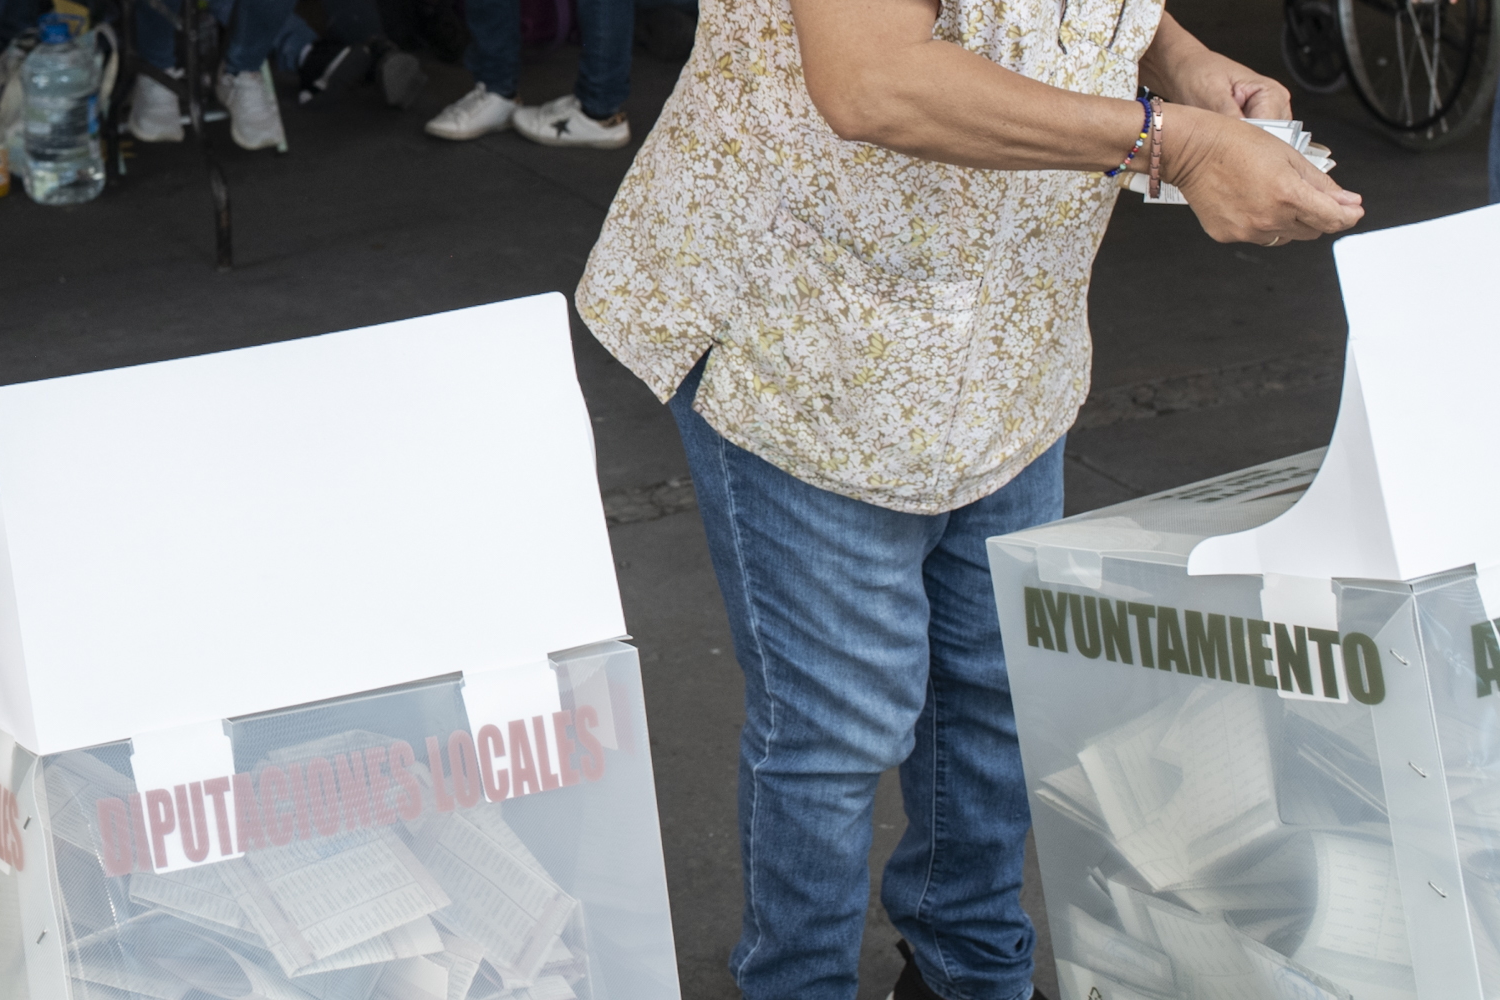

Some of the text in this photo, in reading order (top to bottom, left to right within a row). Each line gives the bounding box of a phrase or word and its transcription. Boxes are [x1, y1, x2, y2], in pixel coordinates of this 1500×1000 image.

[1023, 586, 1386, 706] AYUNTAMIENTO
[96, 740, 424, 878] DIPUTACIONES
[425, 704, 606, 815] LOCALES
